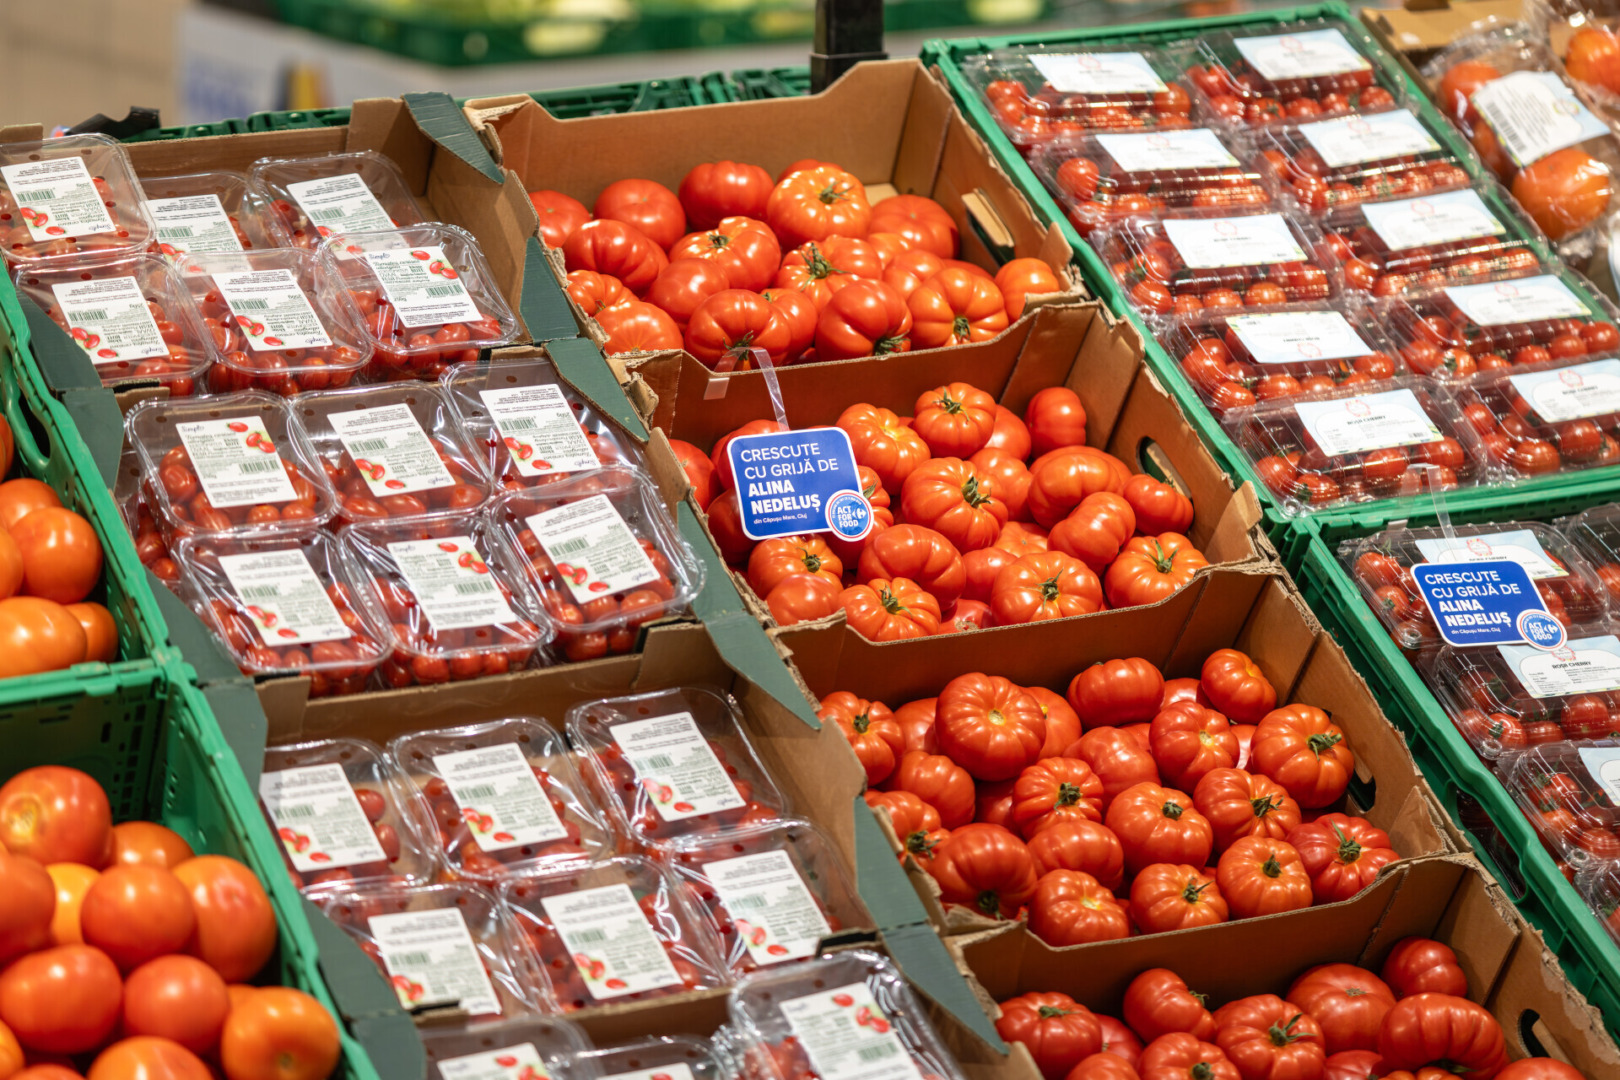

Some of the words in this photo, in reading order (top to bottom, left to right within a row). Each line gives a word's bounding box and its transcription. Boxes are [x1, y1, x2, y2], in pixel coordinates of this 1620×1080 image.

[740, 442, 821, 463] CRESCUTE
[744, 465, 767, 480] CU
[770, 458, 816, 477] GRIJĂ
[818, 458, 839, 472] DE
[748, 479, 795, 498] ALINA
[750, 494, 821, 515] NEDELUȘ
[837, 505, 852, 514] ACT
[838, 513, 853, 521] FOR
[839, 520, 859, 528] FOOD
[1424, 570, 1501, 585] CRESCUTE
[1431, 587, 1453, 599] CU
[1457, 582, 1500, 598] GRIJĂ
[1500, 583, 1522, 595] DE
[1439, 599, 1484, 613] ALINA
[1444, 612, 1512, 628] NEDELUȘ
[1530, 628, 1545, 636] FOR
